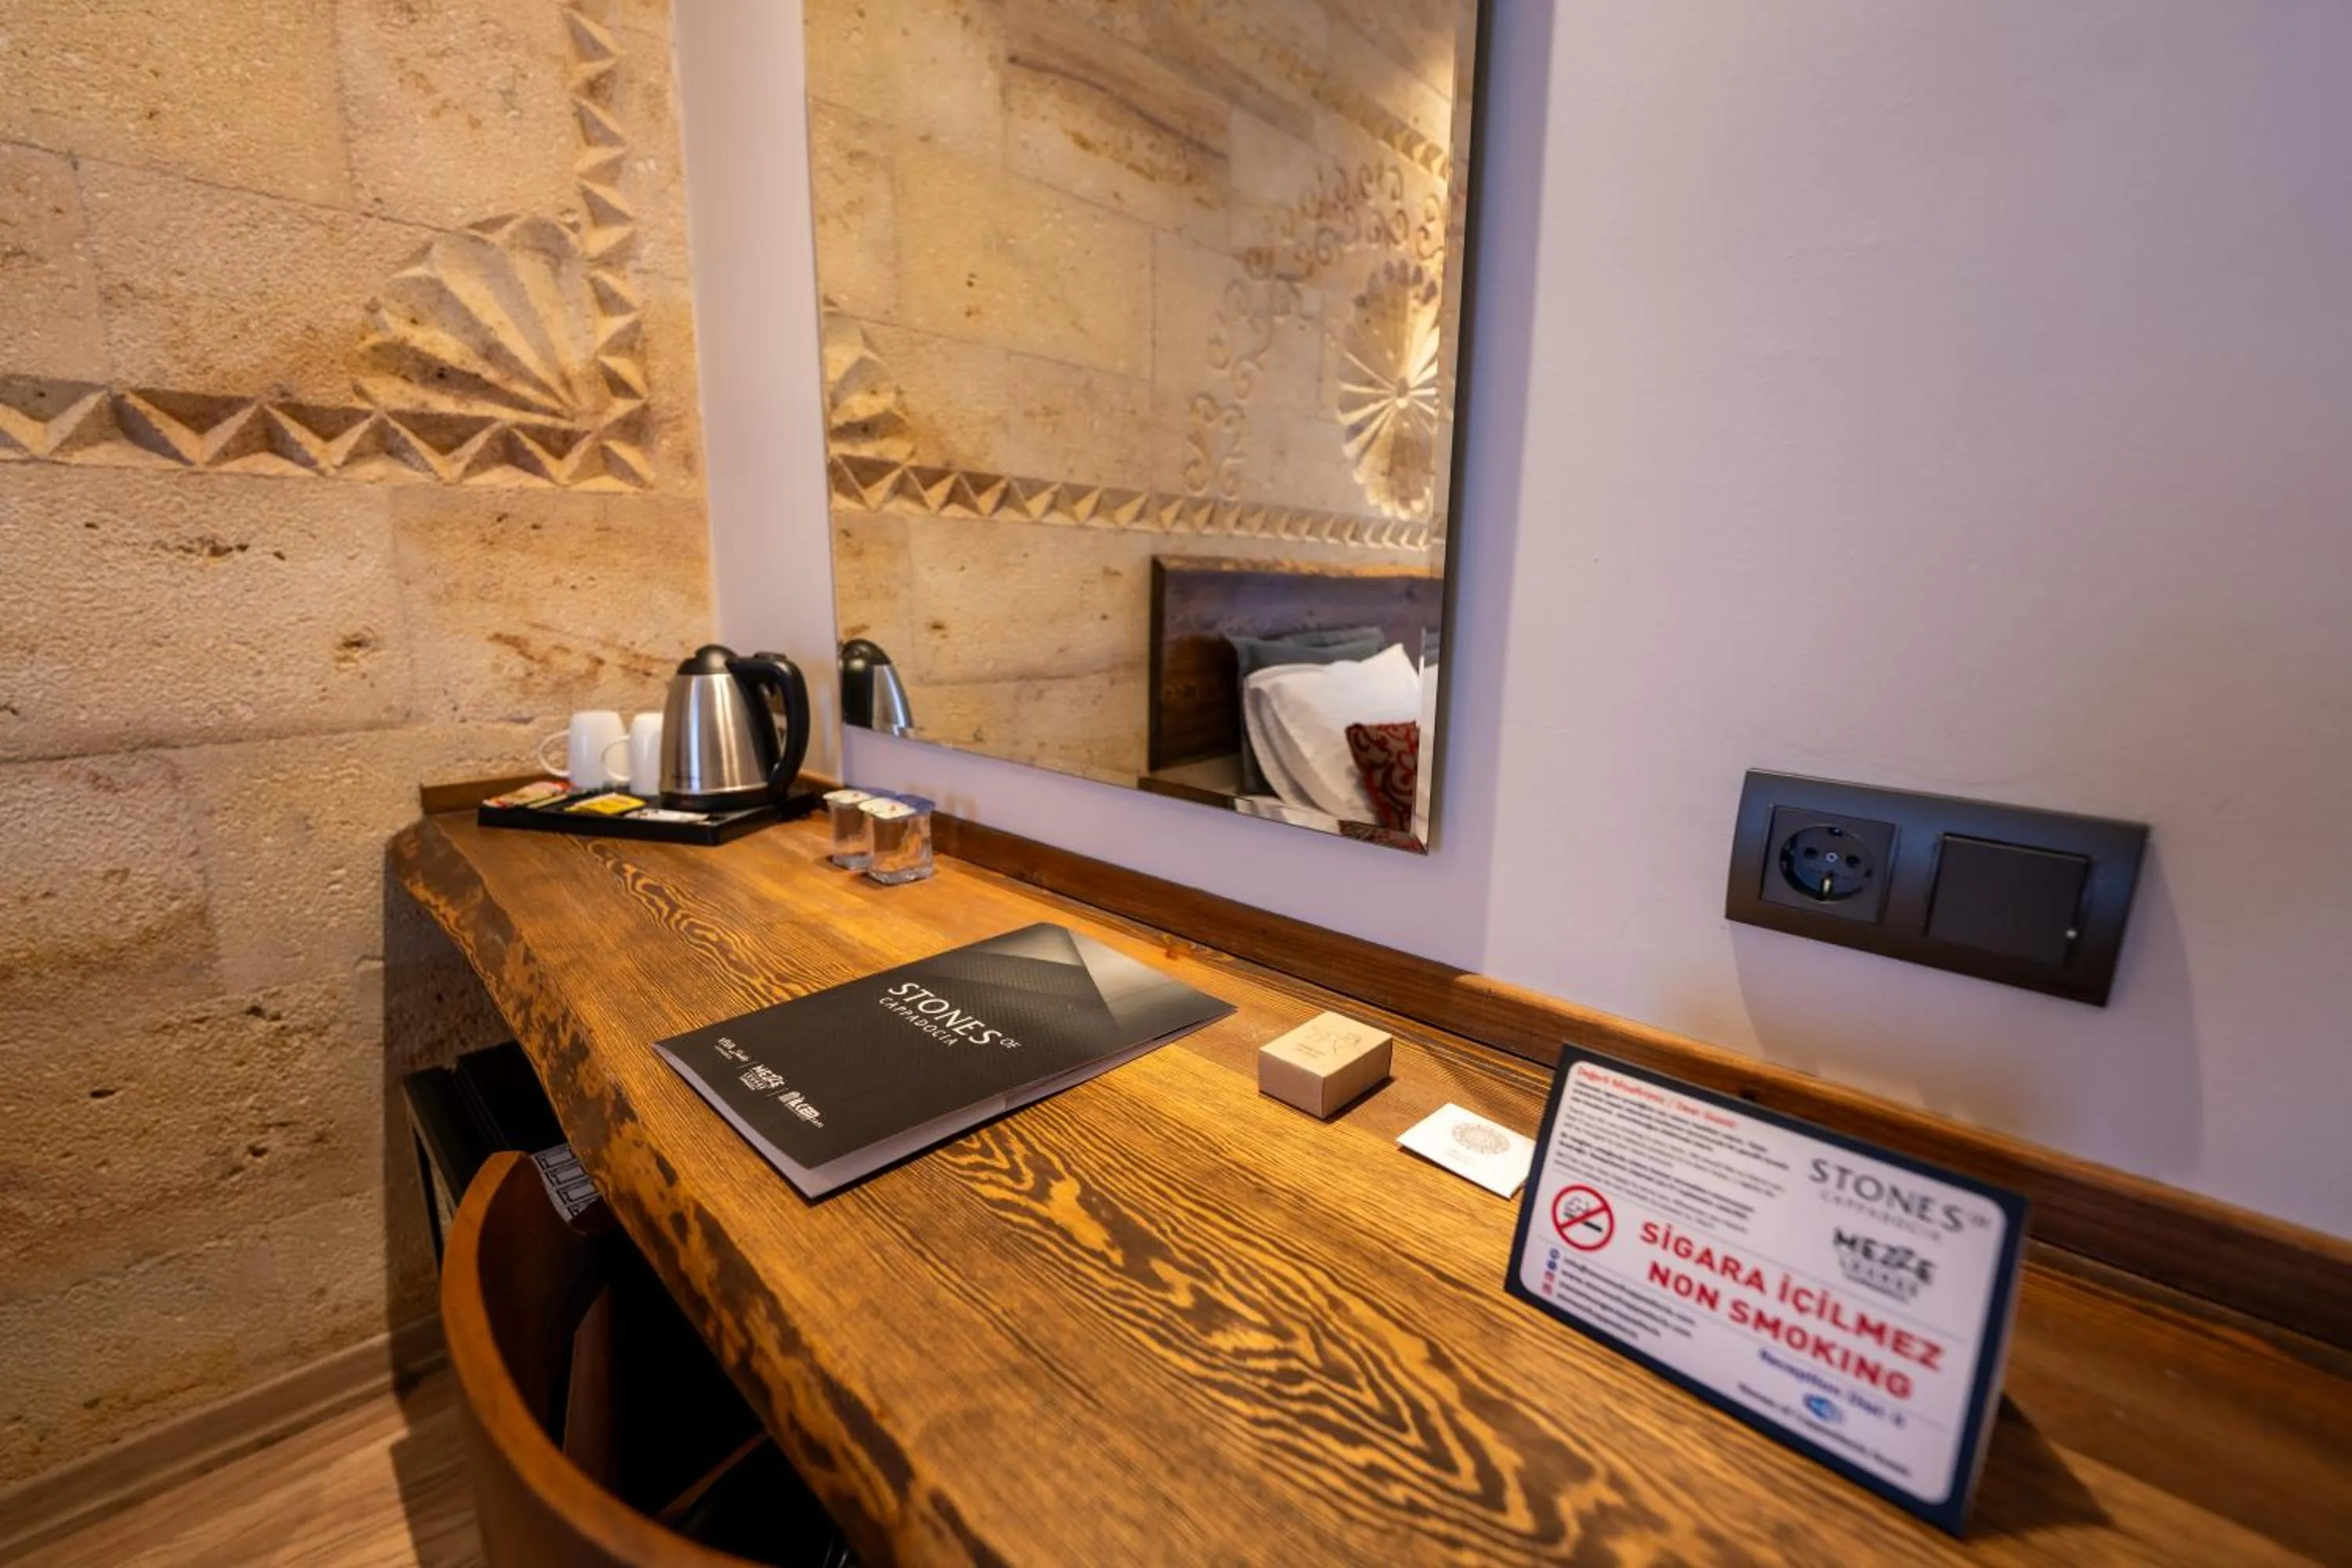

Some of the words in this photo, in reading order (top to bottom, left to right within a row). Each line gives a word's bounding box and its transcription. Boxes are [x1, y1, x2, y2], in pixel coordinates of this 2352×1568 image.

[879, 996, 959, 1047] CAPPADOCIA
[887, 982, 1003, 1044] STONES
[1000, 1037, 1021, 1048] OF
[1808, 1157, 1964, 1233] STONES
[1639, 1220, 1767, 1294] SİGARA
[1777, 1272, 1945, 1372] İÇİLMEZ
[1647, 1260, 1719, 1312] NON
[1728, 1298, 1914, 1401] SMOKING
